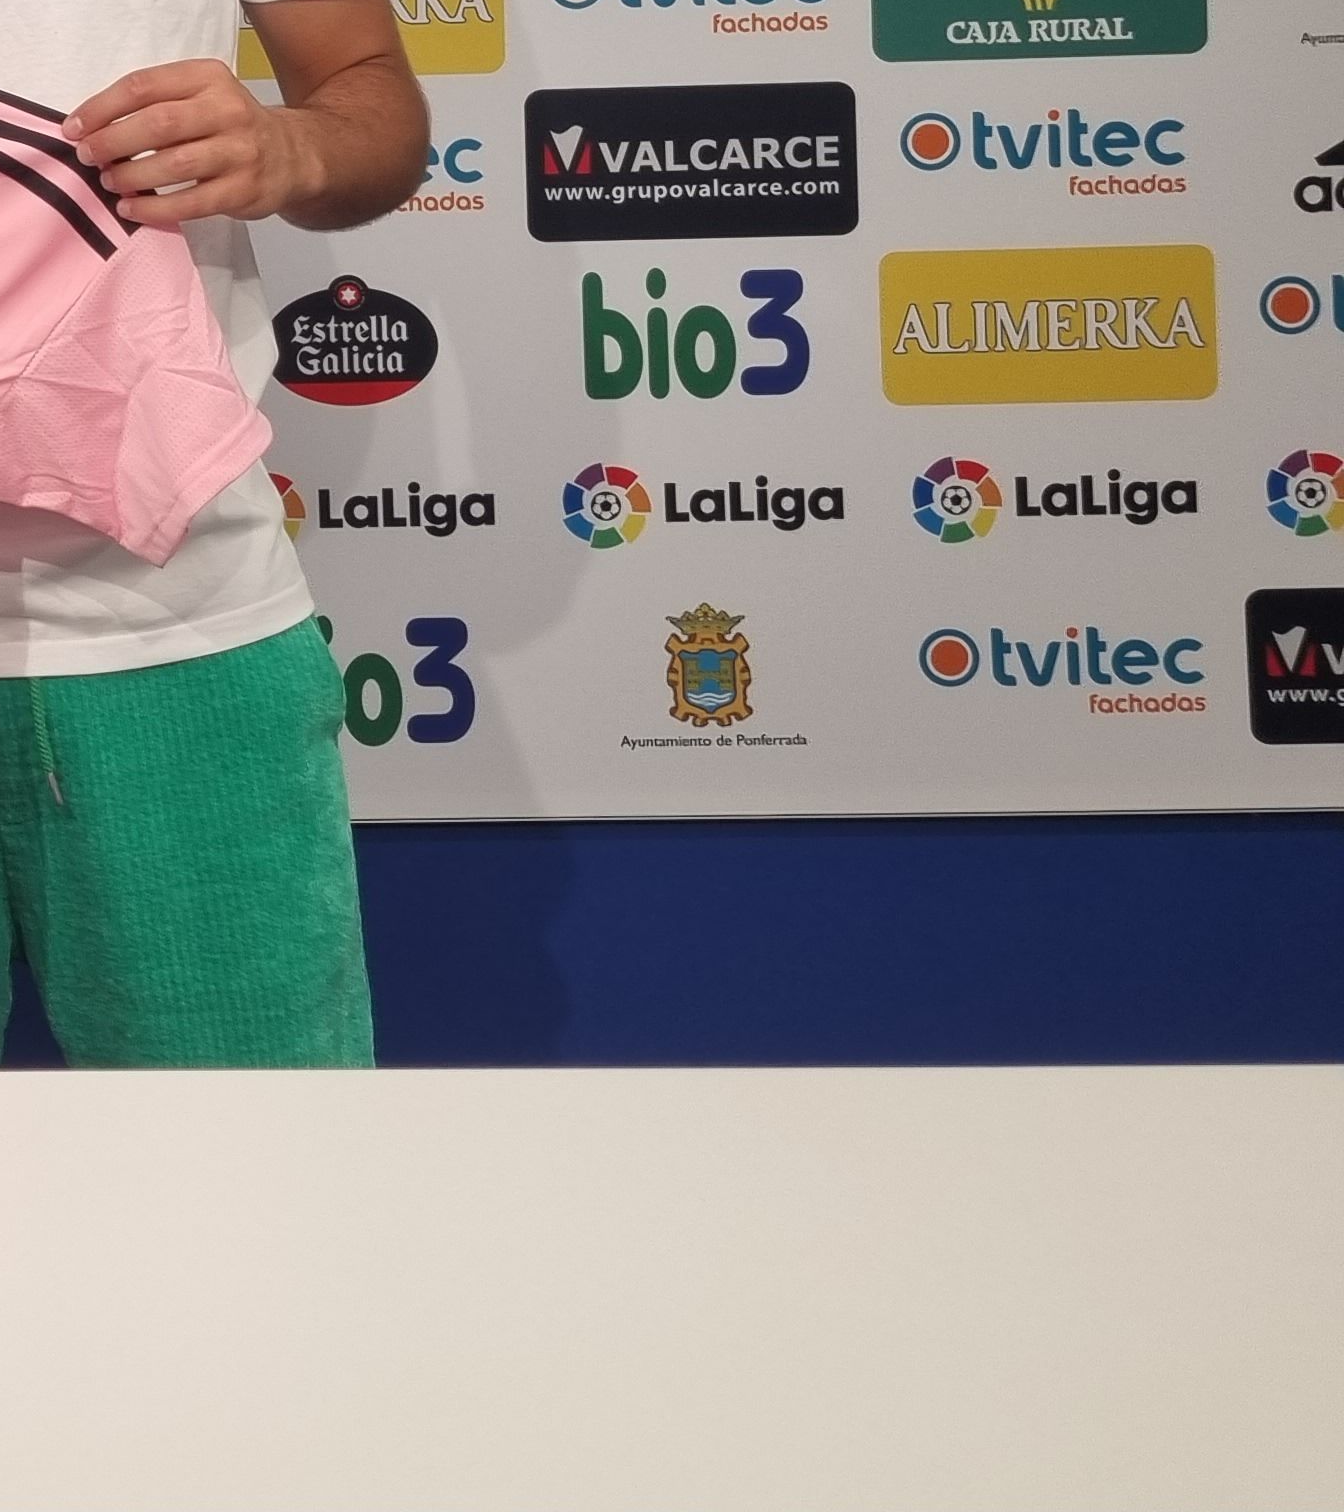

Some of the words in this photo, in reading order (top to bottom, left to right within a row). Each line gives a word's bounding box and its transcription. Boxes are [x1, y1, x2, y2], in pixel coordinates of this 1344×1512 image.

[713, 10, 829, 34] fachadas
[947, 20, 1019, 45] CAJA
[1028, 15, 1132, 41] RURAL
[599, 135, 839, 174] VALCARCE
[973, 109, 1185, 169] tvitec
[545, 176, 840, 205] www.grupovalcarce.com
[1068, 172, 1186, 198] fachadas
[290, 315, 408, 345] Estrella
[582, 266, 810, 401] bio3
[892, 297, 1205, 356] ALIMERKA
[295, 345, 405, 377] Galicia
[319, 482, 496, 537] LaLiga
[664, 475, 844, 531] LaLiga
[1015, 469, 1197, 526] LaLiga
[992, 626, 1204, 687] tvitec
[1089, 691, 1205, 715] fachadas
[620, 733, 713, 750] Ayuntamiento
[716, 733, 732, 747] de
[736, 732, 808, 747] Ponferrada
